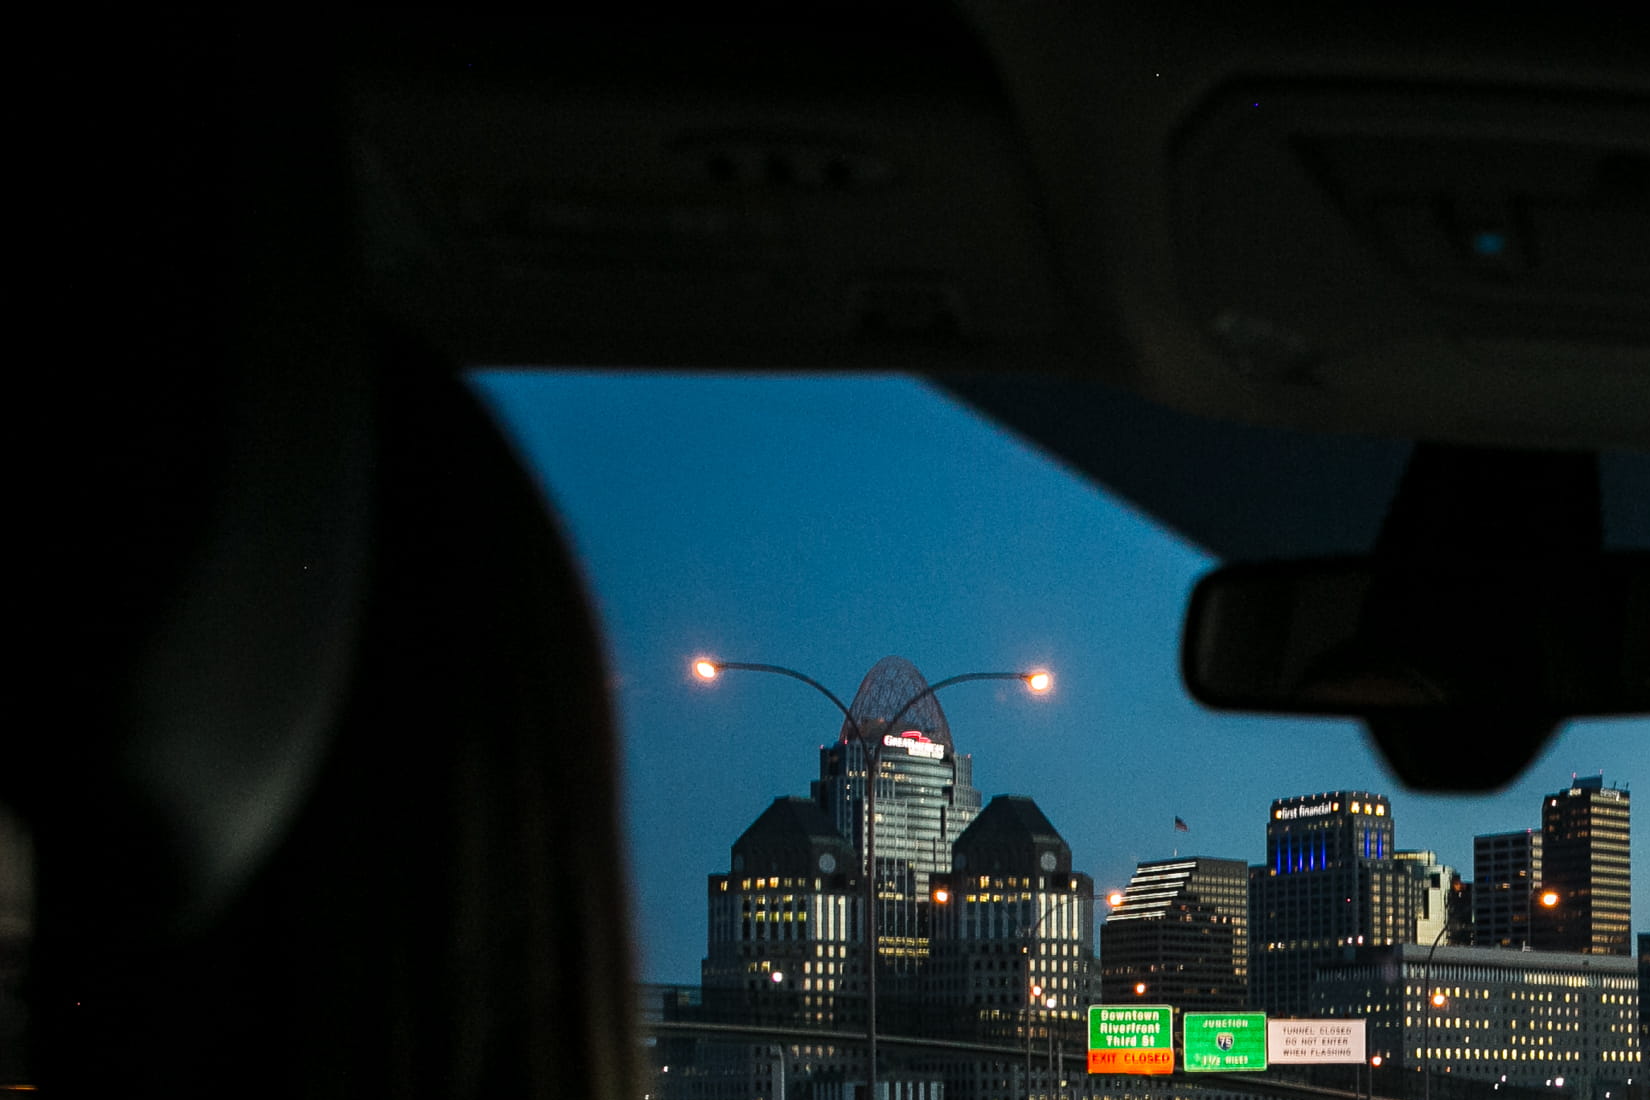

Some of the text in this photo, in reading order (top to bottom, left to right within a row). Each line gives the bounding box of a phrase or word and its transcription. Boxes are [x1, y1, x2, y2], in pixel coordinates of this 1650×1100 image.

[1281, 801, 1332, 820] first financial
[1101, 1010, 1159, 1021] Downtown
[1100, 1022, 1160, 1034] Riverfront
[1202, 1019, 1249, 1028] JUNCTION
[1283, 1026, 1352, 1036] TUNNEL CLOSED
[1106, 1035, 1155, 1047] Third St
[1219, 1037, 1232, 1048] 75
[1285, 1037, 1348, 1046] DO NOT ENTER
[1283, 1048, 1351, 1057] WHEN FLASHING
[1092, 1053, 1170, 1065] EXIT CLOSED
